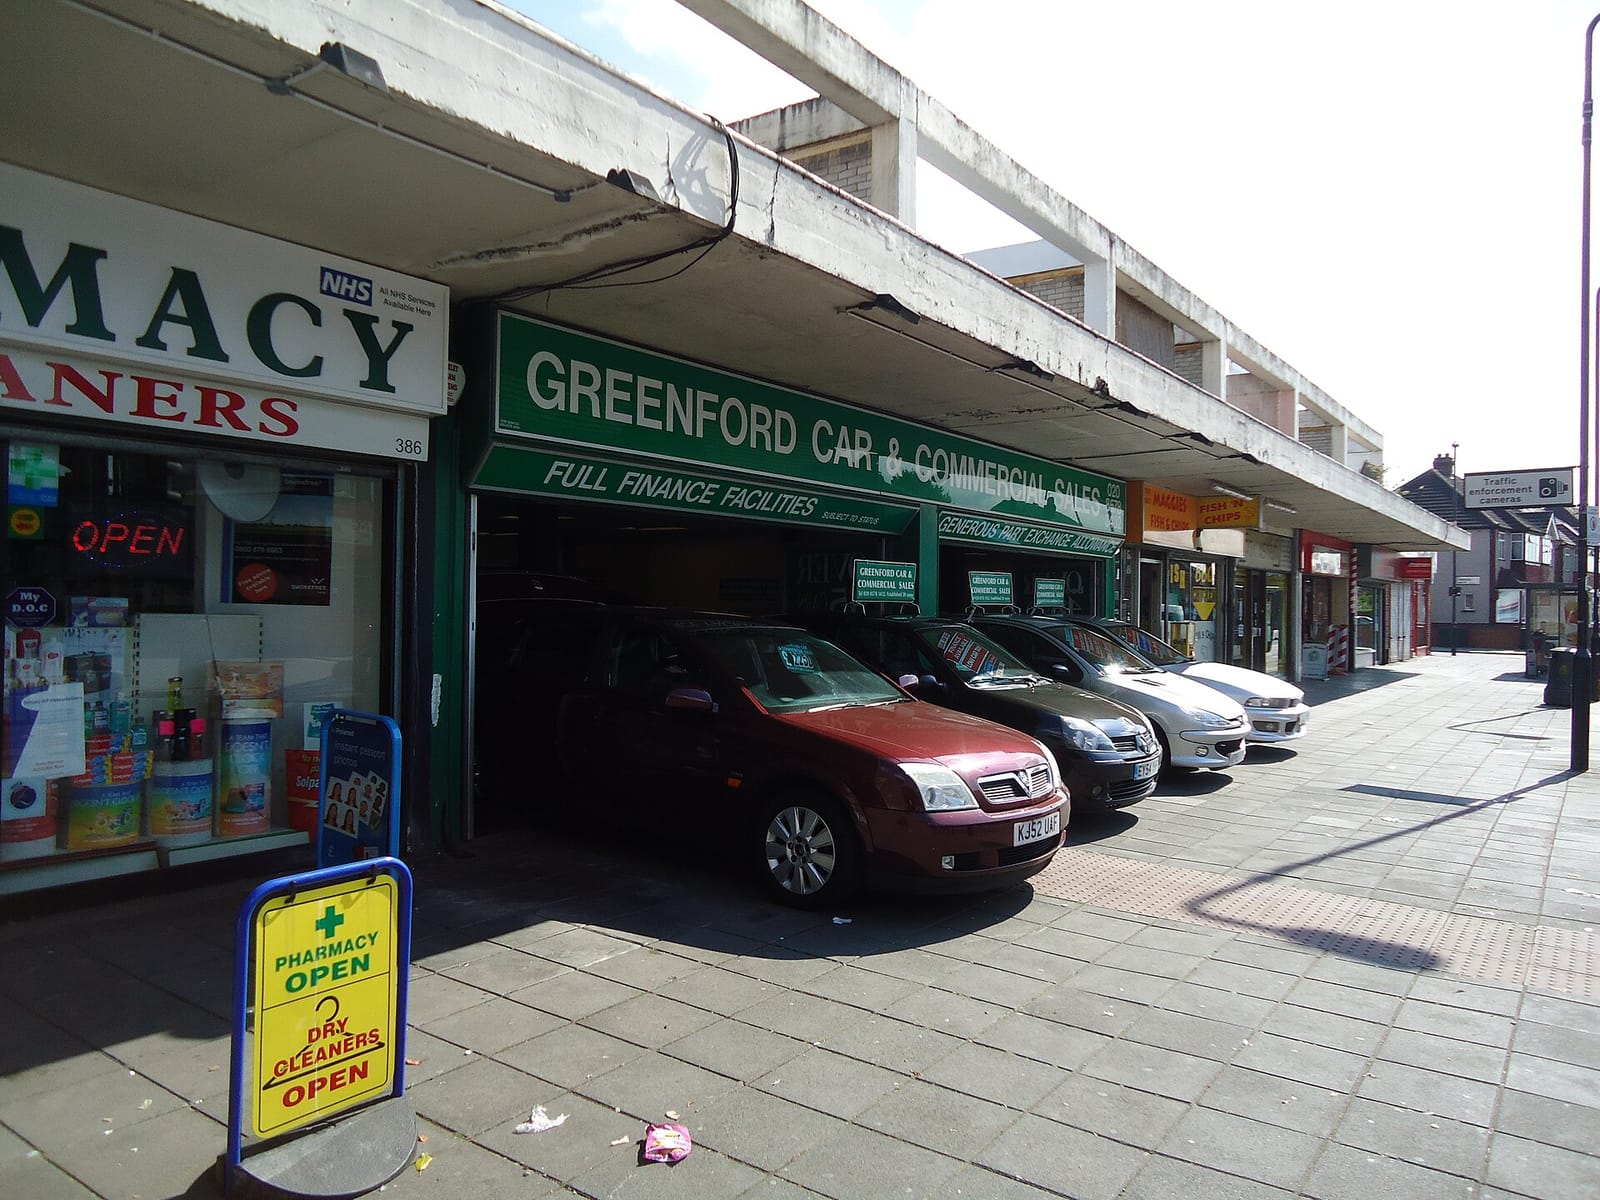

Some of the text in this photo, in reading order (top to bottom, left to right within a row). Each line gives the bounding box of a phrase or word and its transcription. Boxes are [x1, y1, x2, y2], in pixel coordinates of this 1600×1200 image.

[322, 271, 371, 302] NHS
[379, 287, 436, 308] All NHS Services
[383, 298, 432, 317] Available Here
[526, 351, 1101, 516] GREENFORD CAR & COMMERCIAL SALES
[395, 438, 422, 456] 386
[544, 461, 818, 516] FULL FINANCE FACILITIES
[1484, 477, 1517, 485] Traffic
[1107, 483, 1120, 499] 020
[1469, 486, 1532, 496] enforcement
[1480, 496, 1521, 504] cameras
[1152, 492, 1188, 512] MAGGIES
[1200, 501, 1227, 513] FISH
[821, 511, 880, 525] SUBJECT TO STATUS
[1150, 514, 1165, 528] FISH
[1204, 511, 1241, 524] CHIPS
[72, 520, 185, 555] OPEN
[938, 517, 1000, 538] GENEROUS
[999, 526, 1026, 541] PART
[1024, 529, 1074, 548] EXCHANGE
[859, 567, 895, 577] GREENFORD
[896, 569, 907, 578] CAR
[857, 579, 914, 590] COMMERCIAL SALES
[20, 591, 41, 603] My
[11, 602, 49, 613] D.O.C
[1018, 814, 1058, 842] KJ52 UAF
[275, 931, 379, 972] PHARMACY
[285, 953, 370, 993] OPEN
[308, 1016, 349, 1044] DRY
[273, 1028, 380, 1078] CLEANERS
[282, 1060, 369, 1108] OPEN
